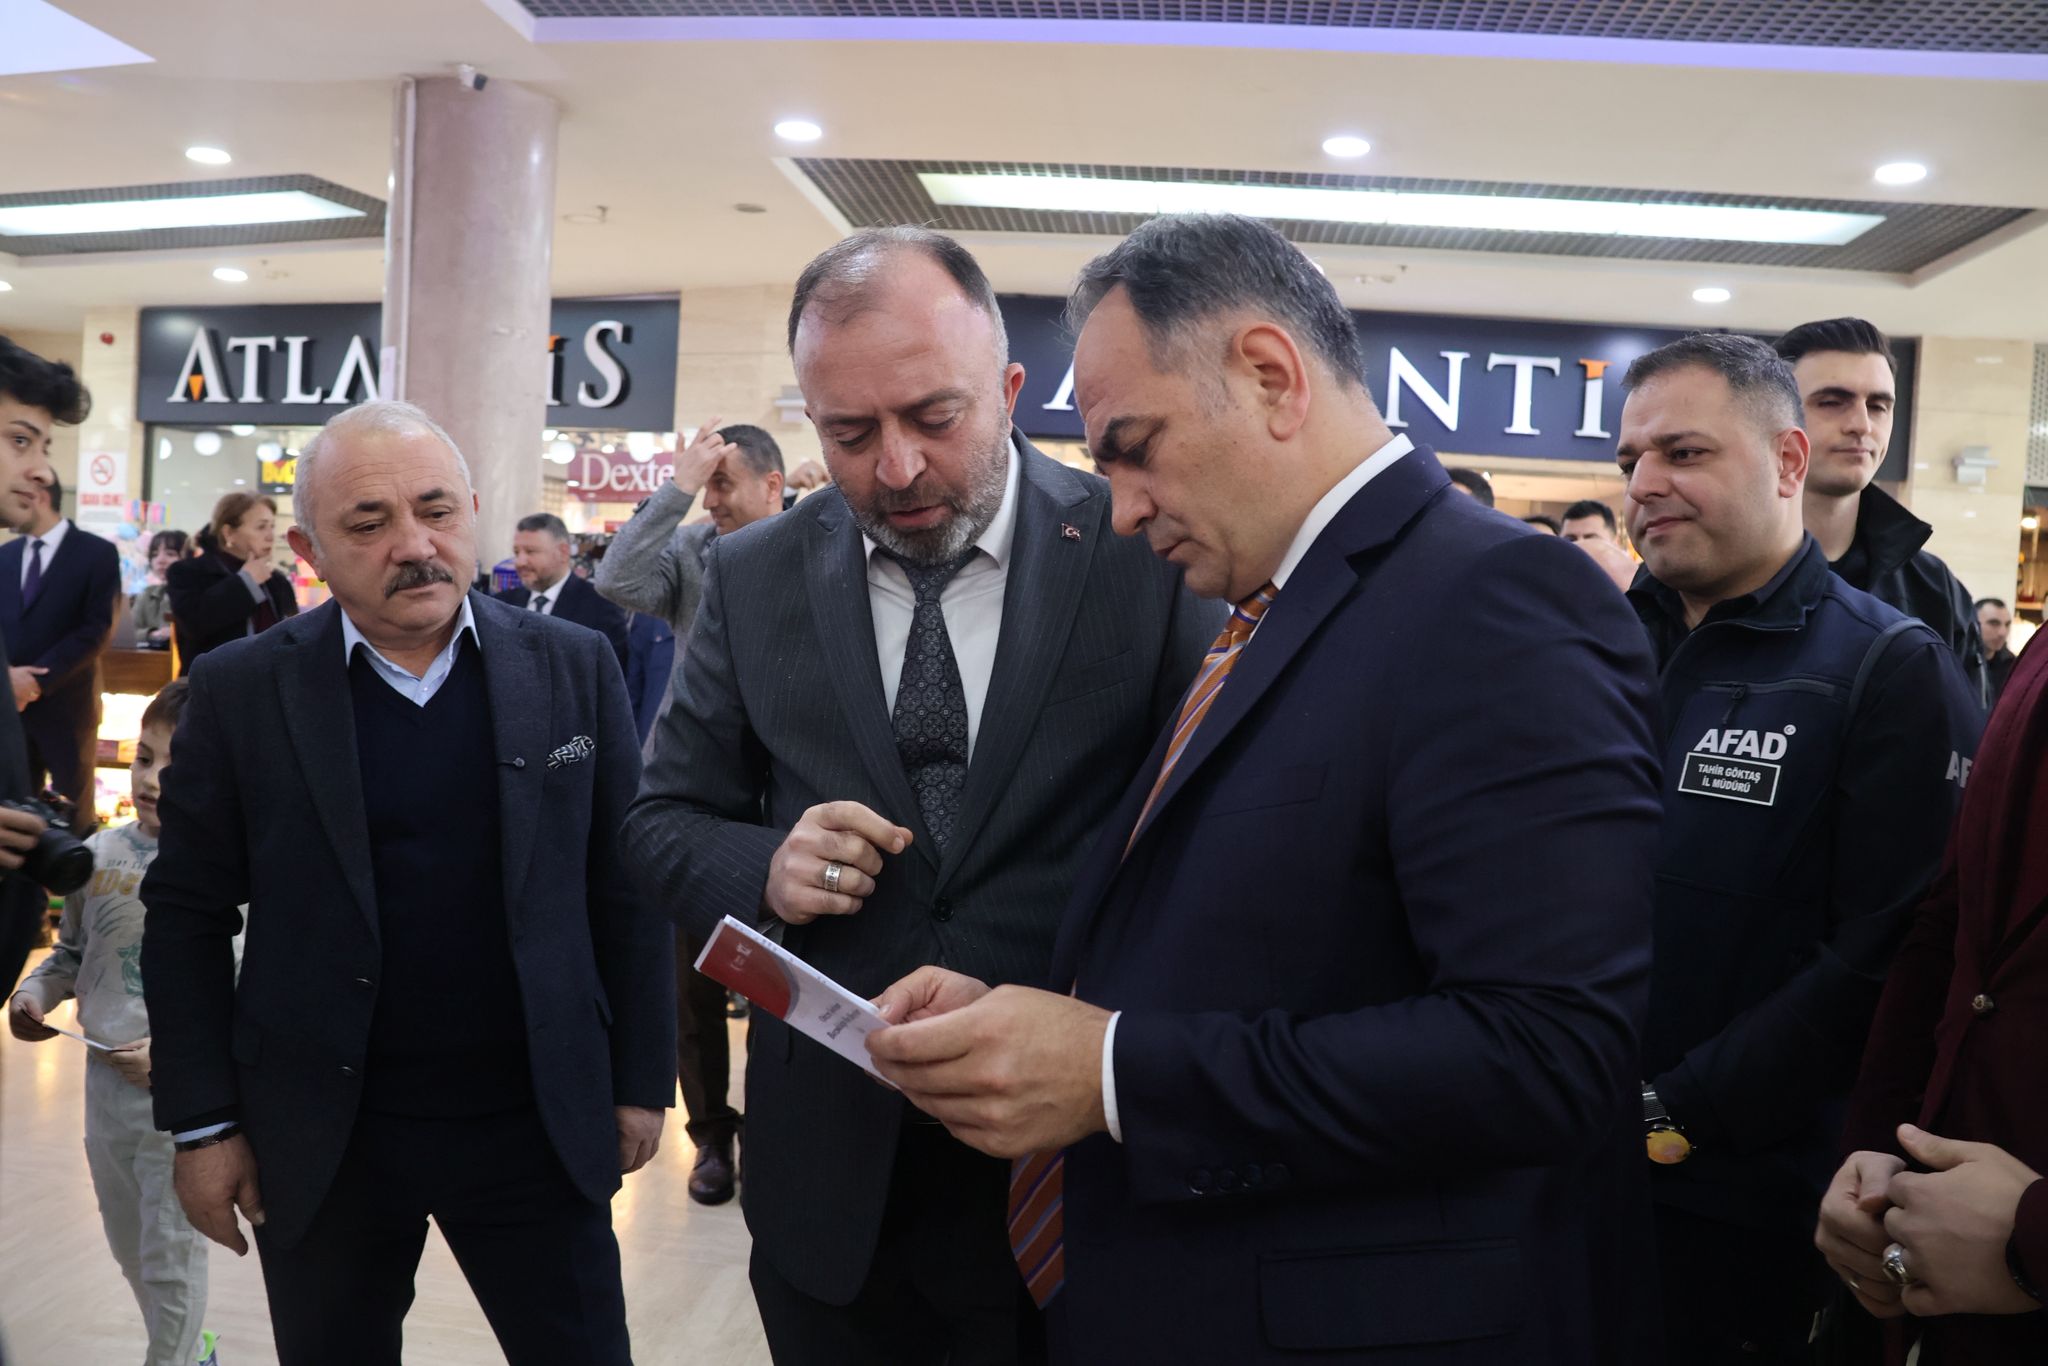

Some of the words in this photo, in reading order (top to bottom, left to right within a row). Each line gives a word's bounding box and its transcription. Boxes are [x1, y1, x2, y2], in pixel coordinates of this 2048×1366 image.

[167, 320, 623, 408] ATLAIS
[580, 453, 675, 492] Dexte
[1693, 728, 1788, 761] AFAD
[1698, 763, 1724, 777] TAHİR
[1725, 766, 1761, 784] GÖKTAŞ
[1701, 776, 1711, 787] İL
[1712, 778, 1751, 793] MÜDÜRÜ
[1945, 750, 1974, 788] AF
